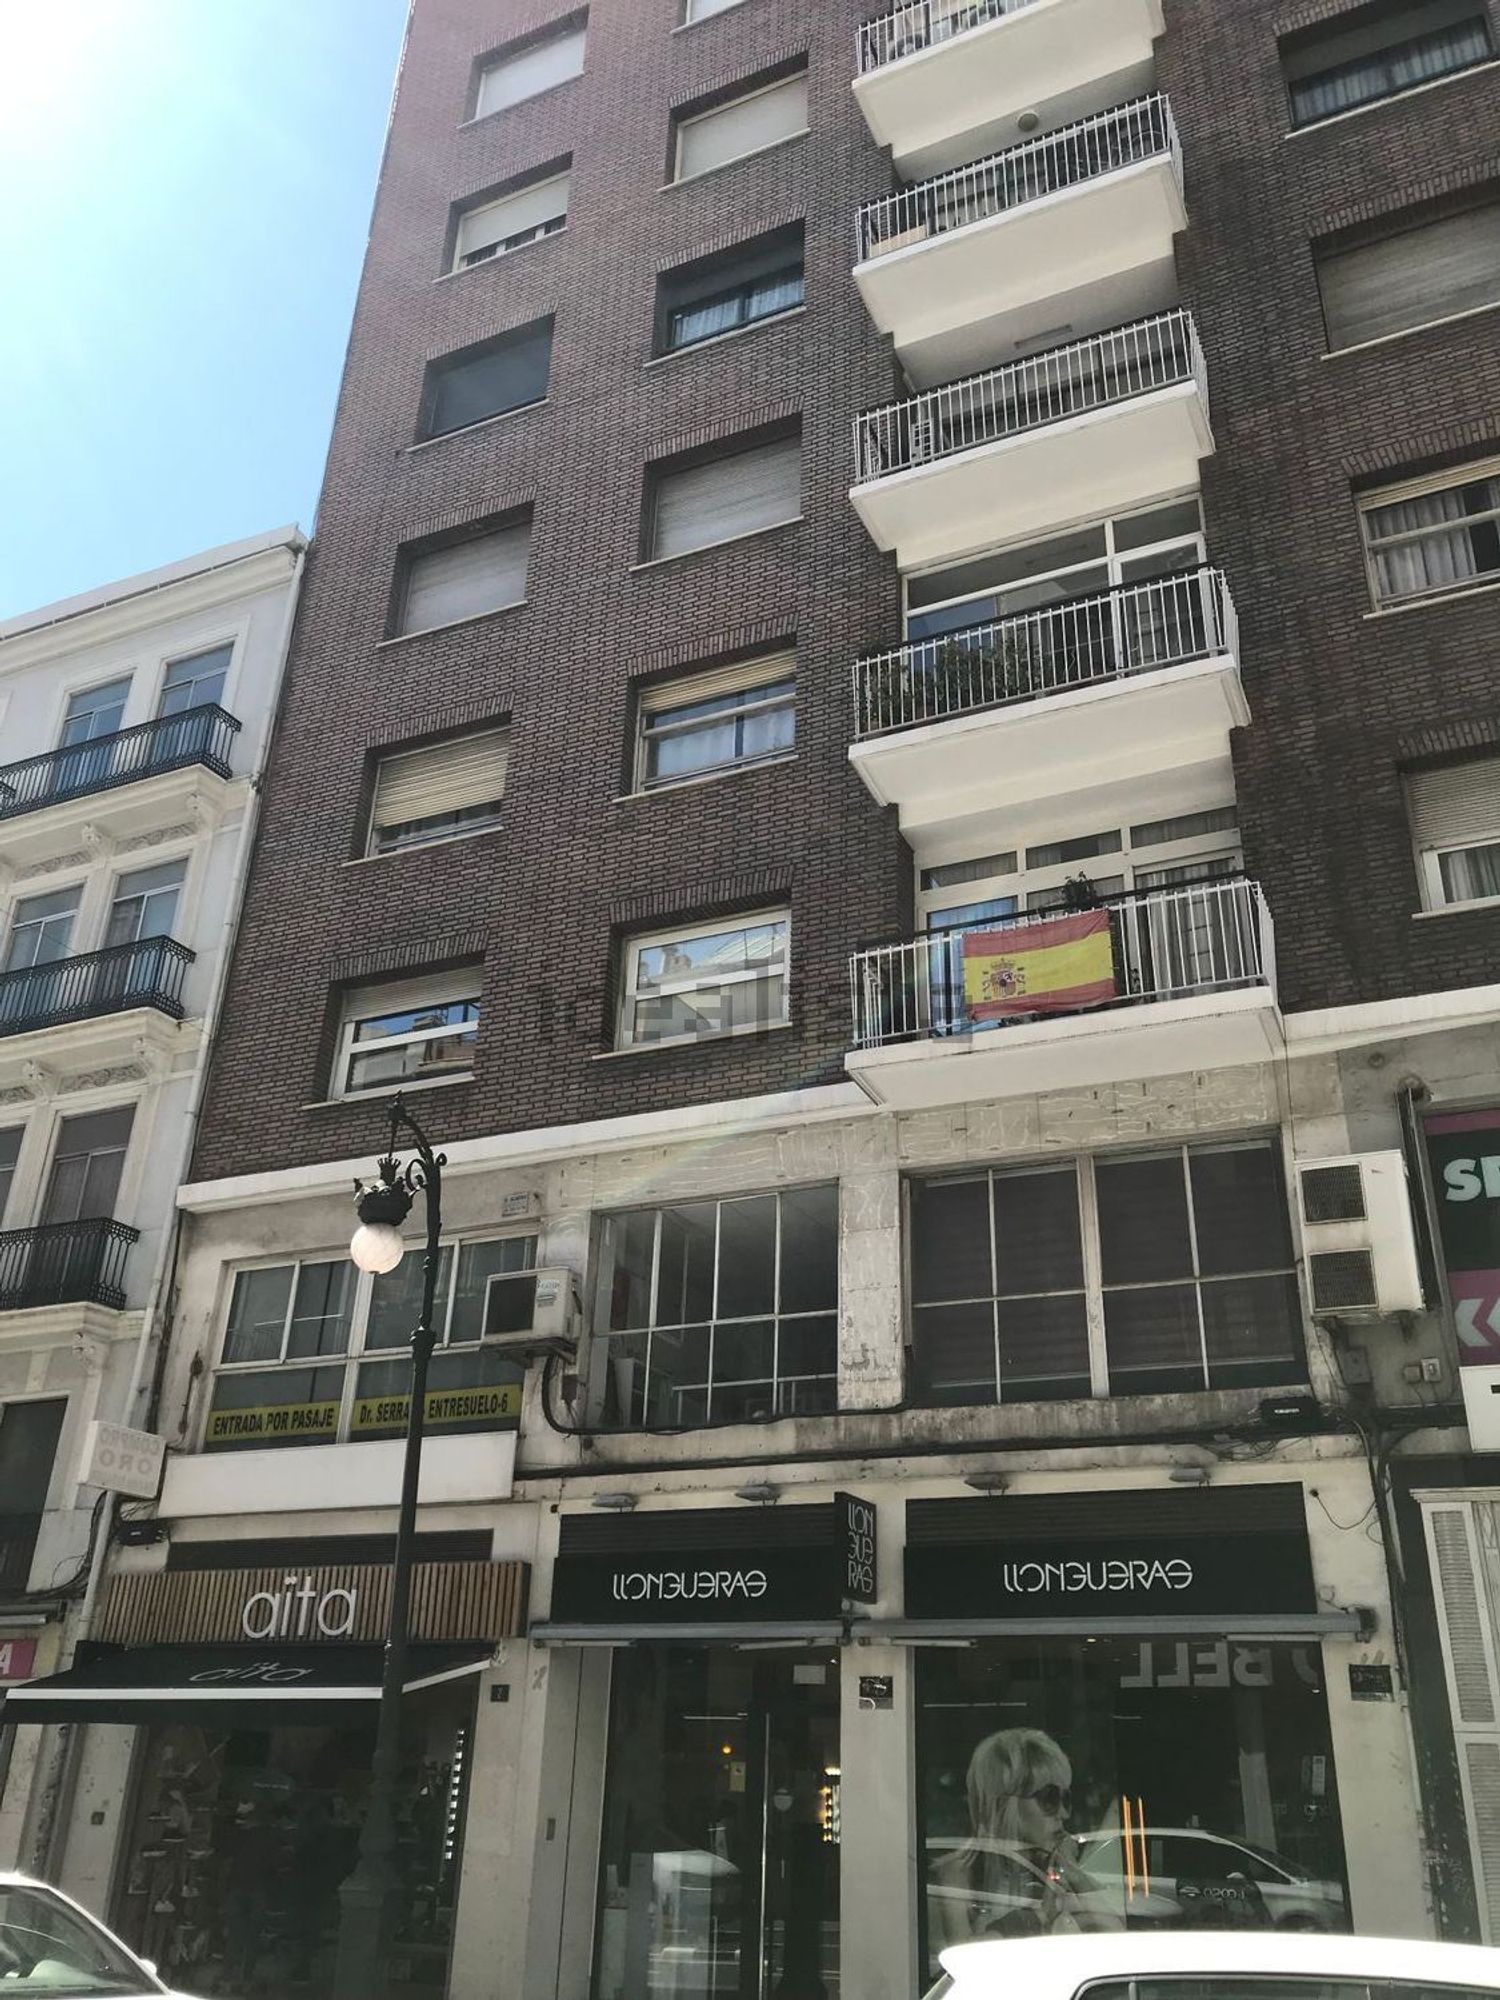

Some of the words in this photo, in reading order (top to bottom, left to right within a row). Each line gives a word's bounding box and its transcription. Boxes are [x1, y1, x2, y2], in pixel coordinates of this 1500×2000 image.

[213, 1414, 263, 1435] ENTRADA
[265, 1411, 289, 1431] POR
[291, 1408, 334, 1430] PASAJE
[360, 1405, 371, 1424] Dr.
